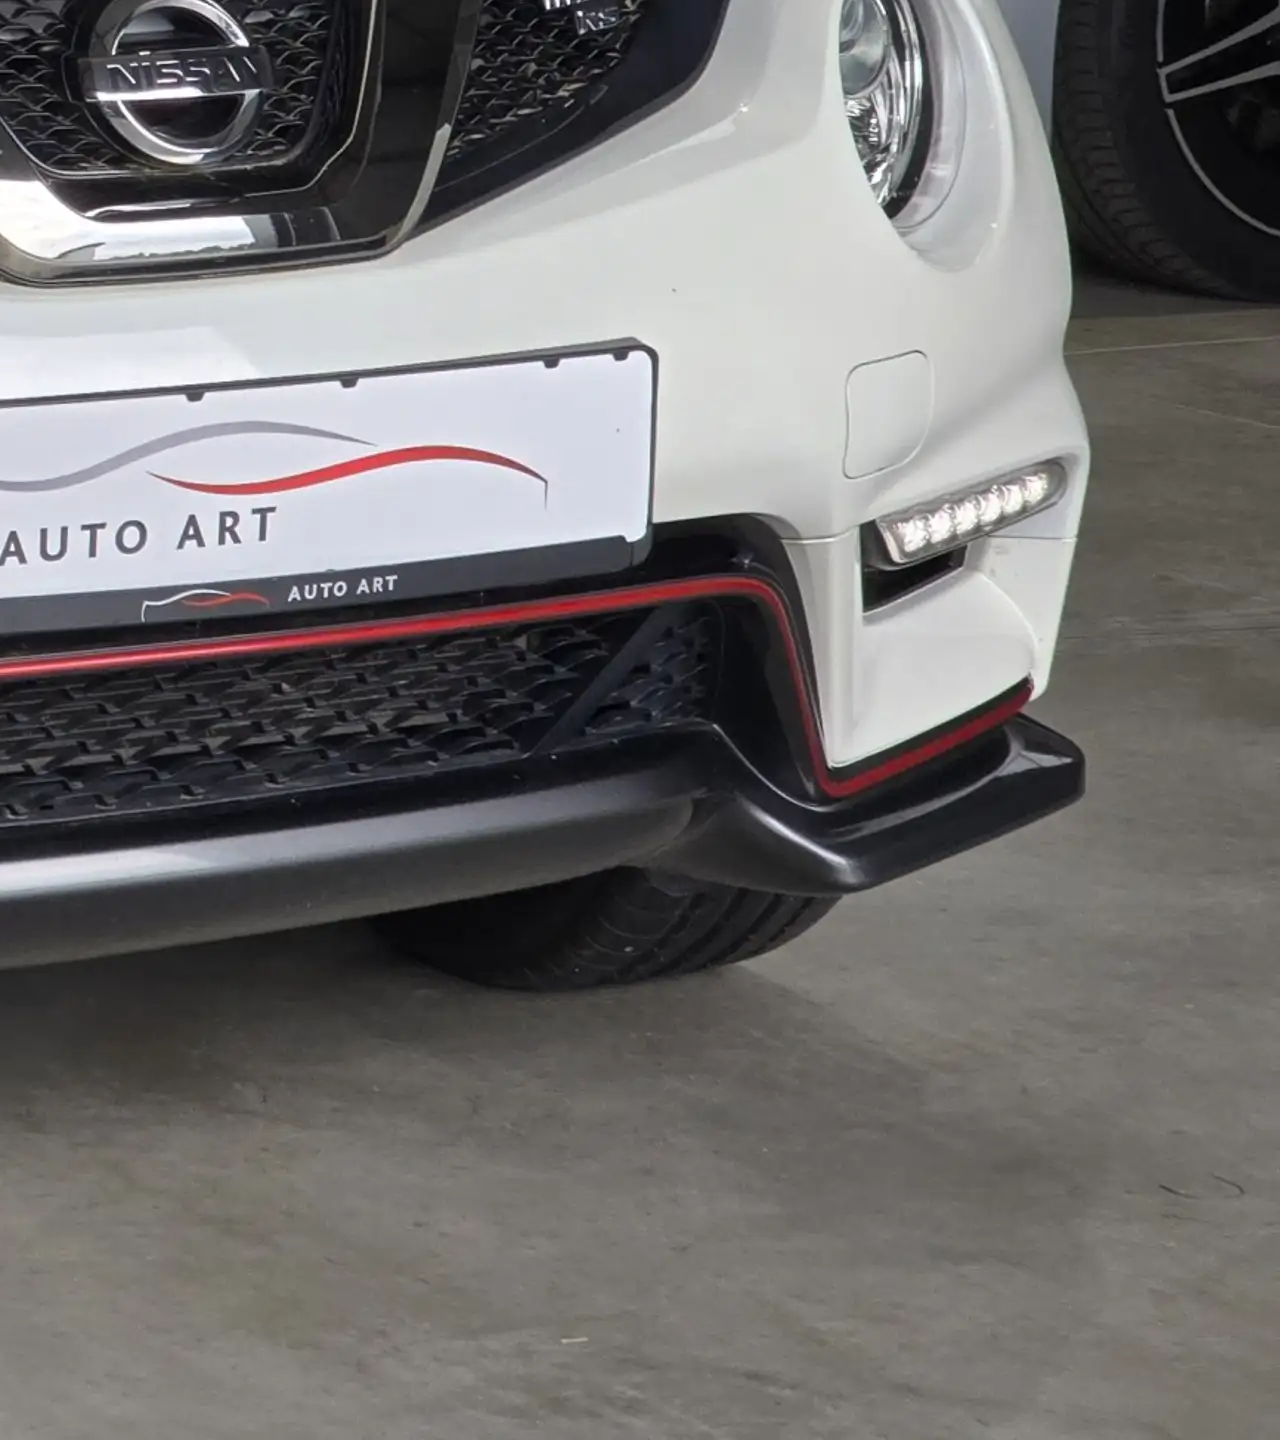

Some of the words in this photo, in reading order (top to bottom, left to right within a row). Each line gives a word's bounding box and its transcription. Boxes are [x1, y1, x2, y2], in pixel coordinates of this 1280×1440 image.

[105, 55, 264, 92] NISSAN
[176, 506, 277, 550] ART
[287, 580, 348, 602] AUTO
[355, 574, 398, 595] ART
